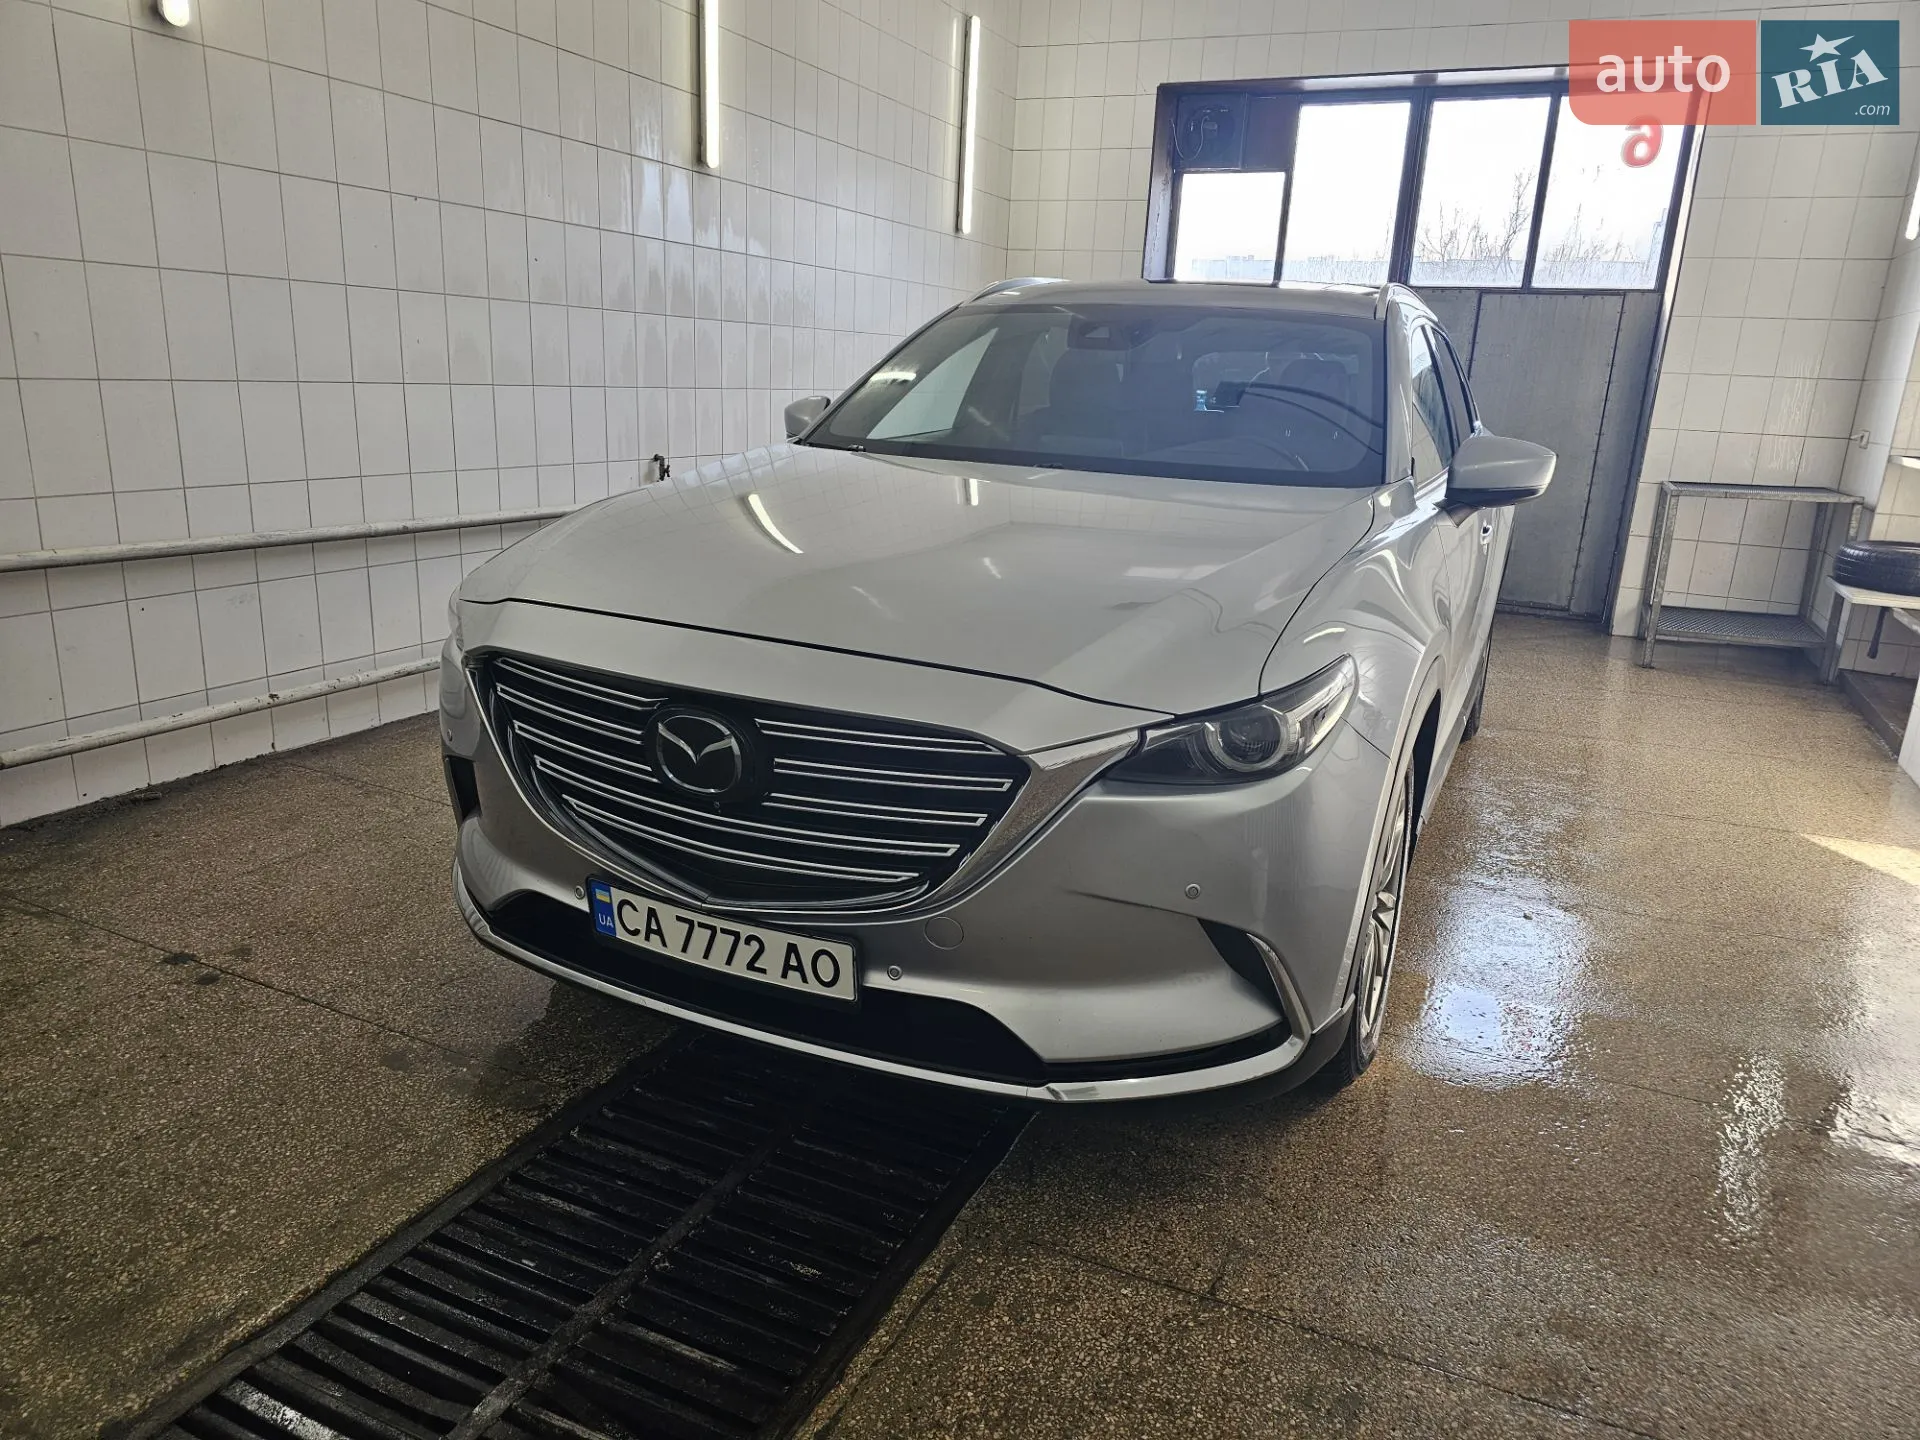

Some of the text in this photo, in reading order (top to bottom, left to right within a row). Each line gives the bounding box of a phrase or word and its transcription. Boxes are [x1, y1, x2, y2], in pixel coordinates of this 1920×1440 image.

[597, 913, 614, 929] UA
[616, 899, 840, 988] CA 7772 AO
